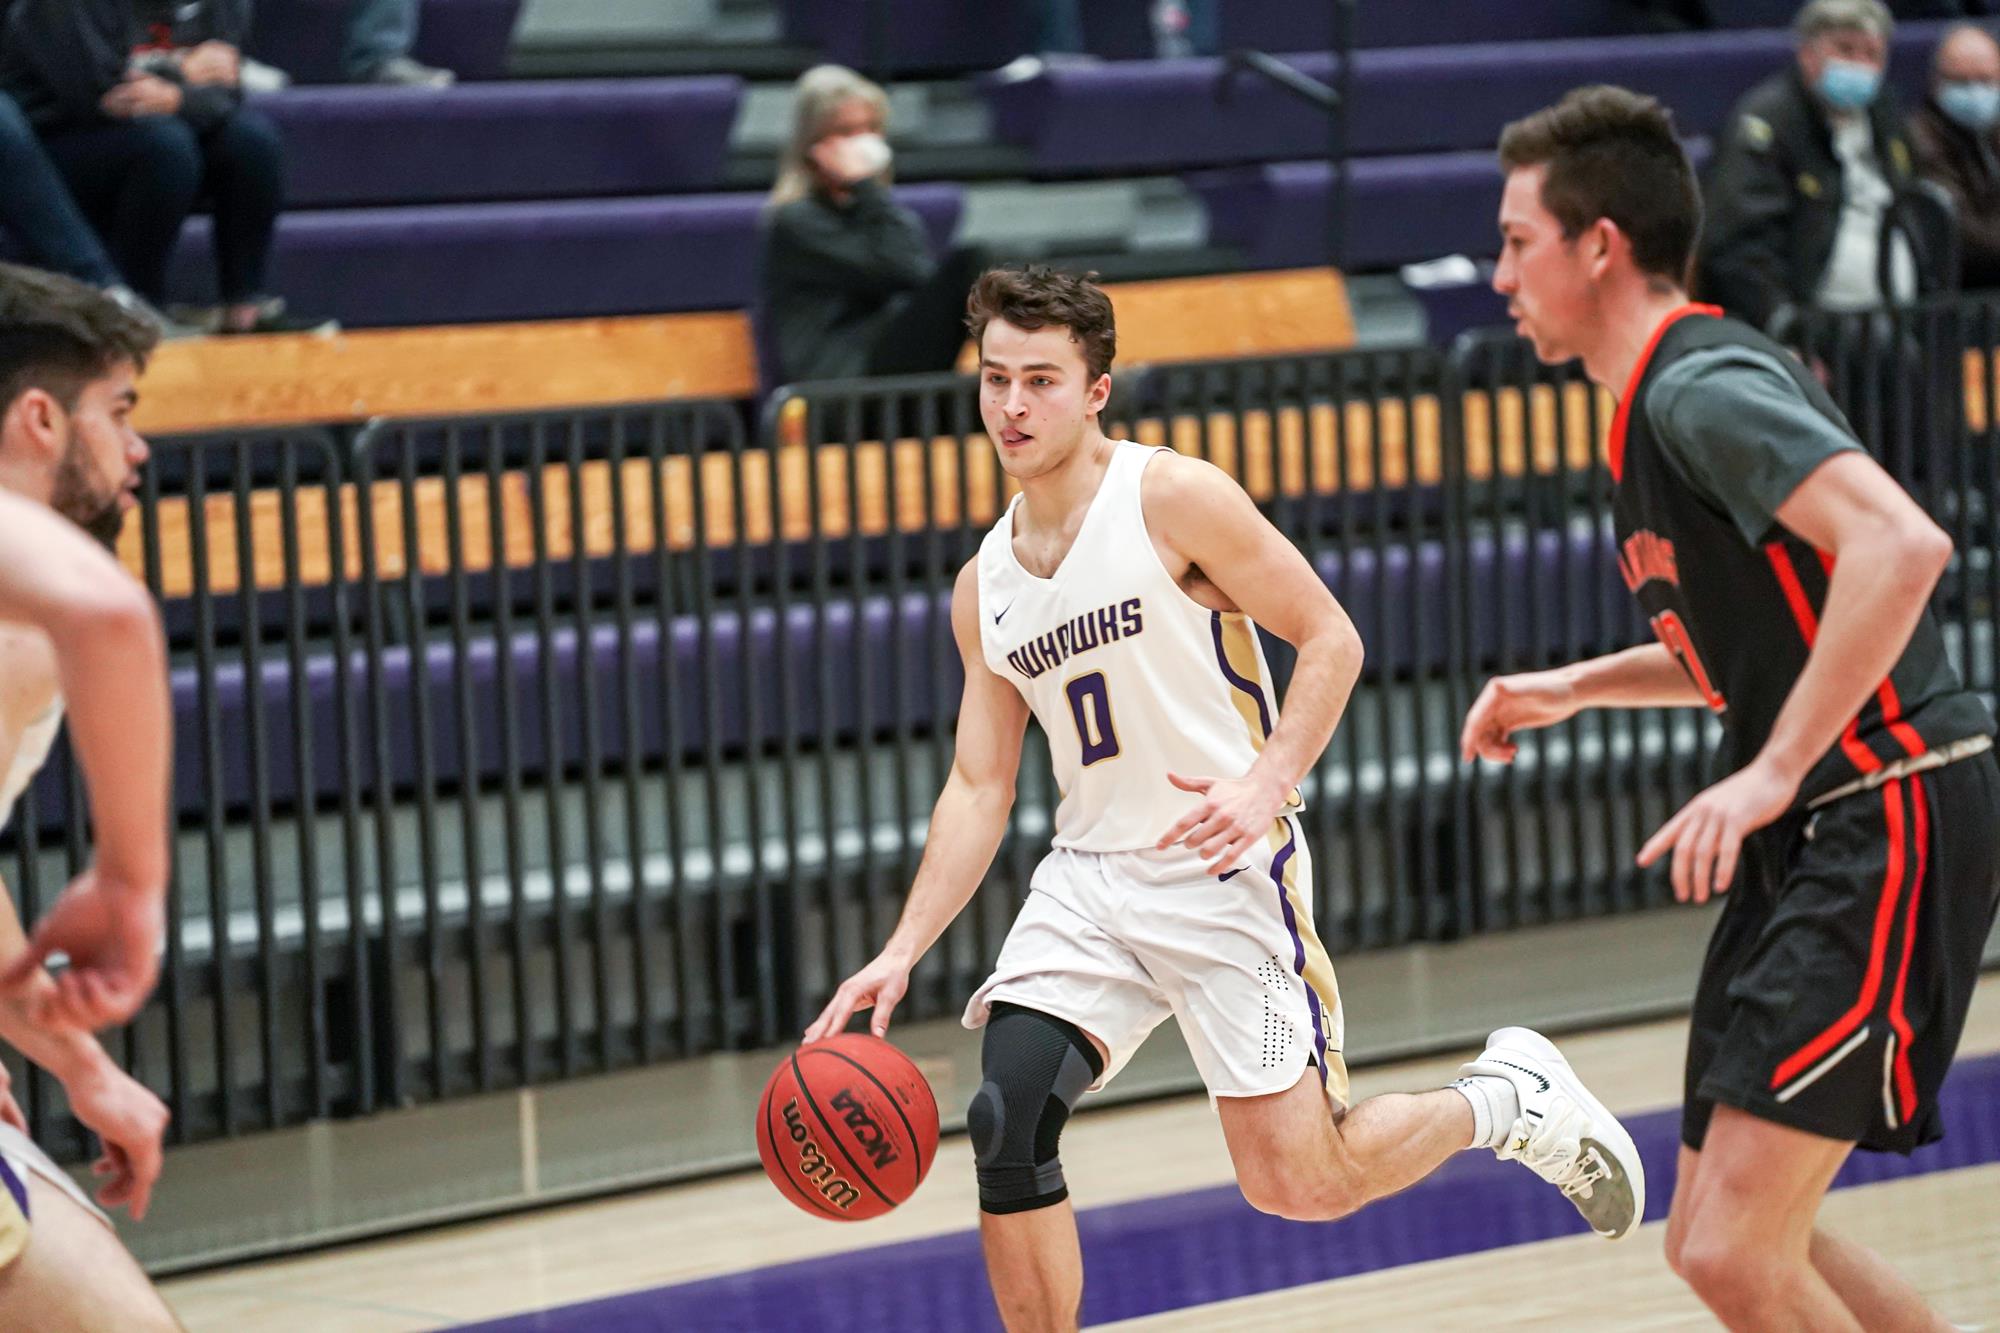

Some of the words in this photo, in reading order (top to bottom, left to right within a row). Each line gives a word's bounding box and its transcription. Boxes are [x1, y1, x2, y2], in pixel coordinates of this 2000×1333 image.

[1064, 668, 1122, 768] 0
[782, 1095, 861, 1211] Wilson
[830, 1087, 899, 1171] NCAA
